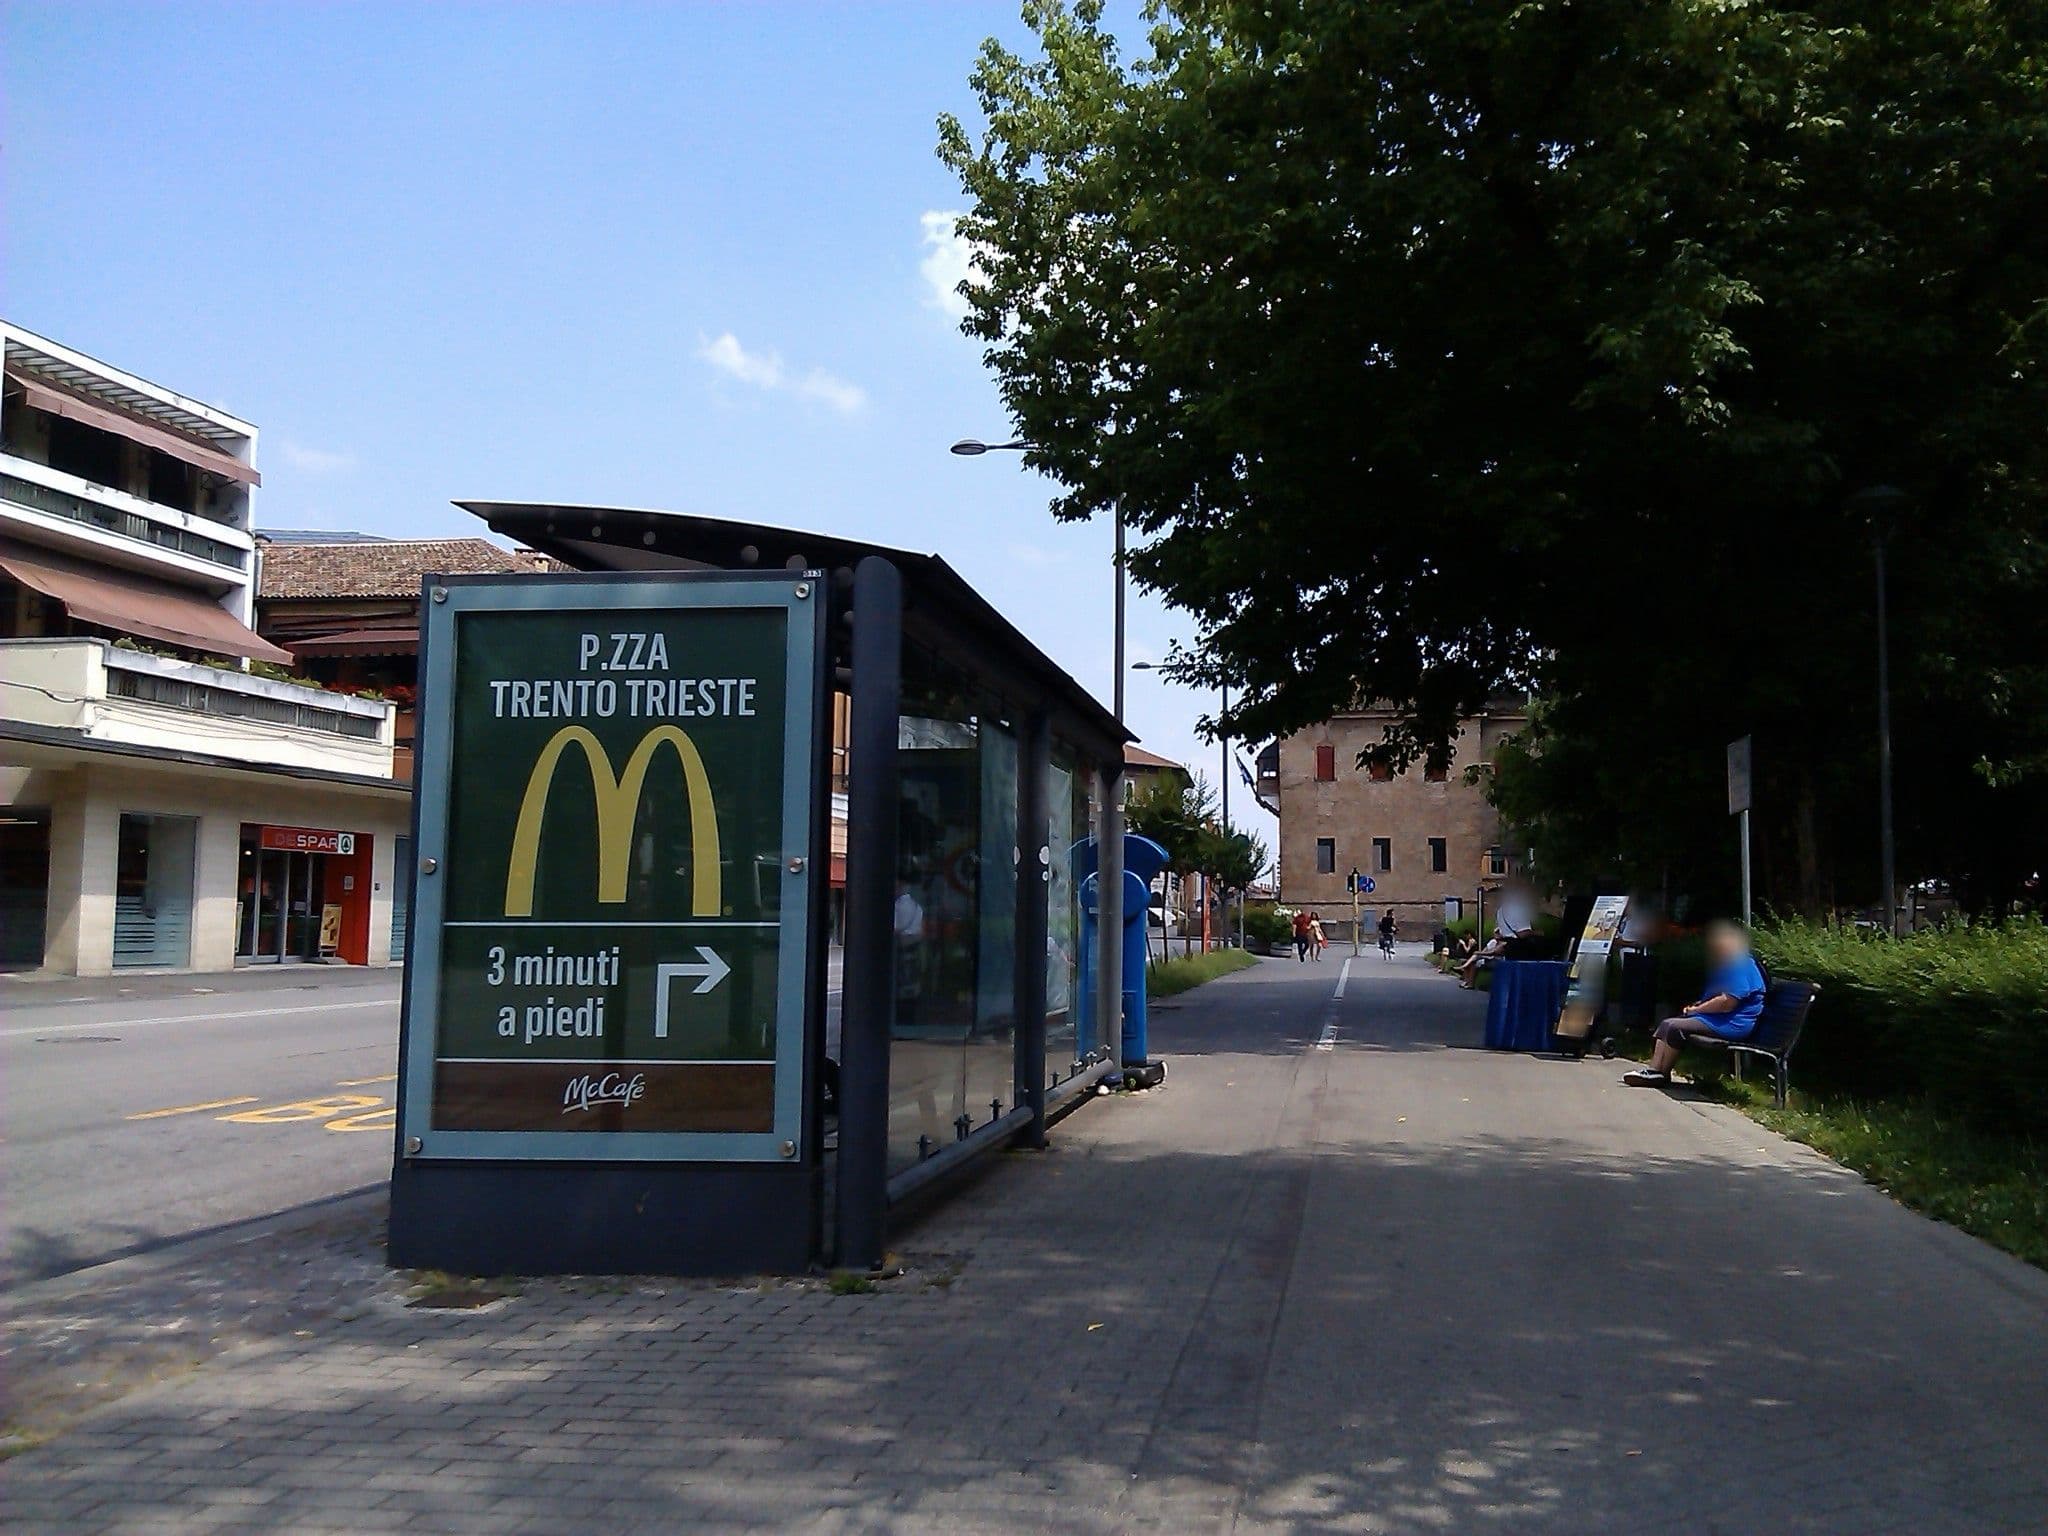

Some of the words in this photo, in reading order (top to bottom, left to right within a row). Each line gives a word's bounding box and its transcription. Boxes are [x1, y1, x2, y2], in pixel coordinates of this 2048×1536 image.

[580, 633, 669, 671] P.ZZA
[490, 680, 617, 717] TRENTO
[625, 679, 757, 717] TRIESTE
[488, 946, 506, 986] 3
[514, 946, 619, 986] minuti
[498, 1005, 516, 1037] a
[525, 997, 604, 1044] piedi
[563, 1072, 646, 1111] McCafé
